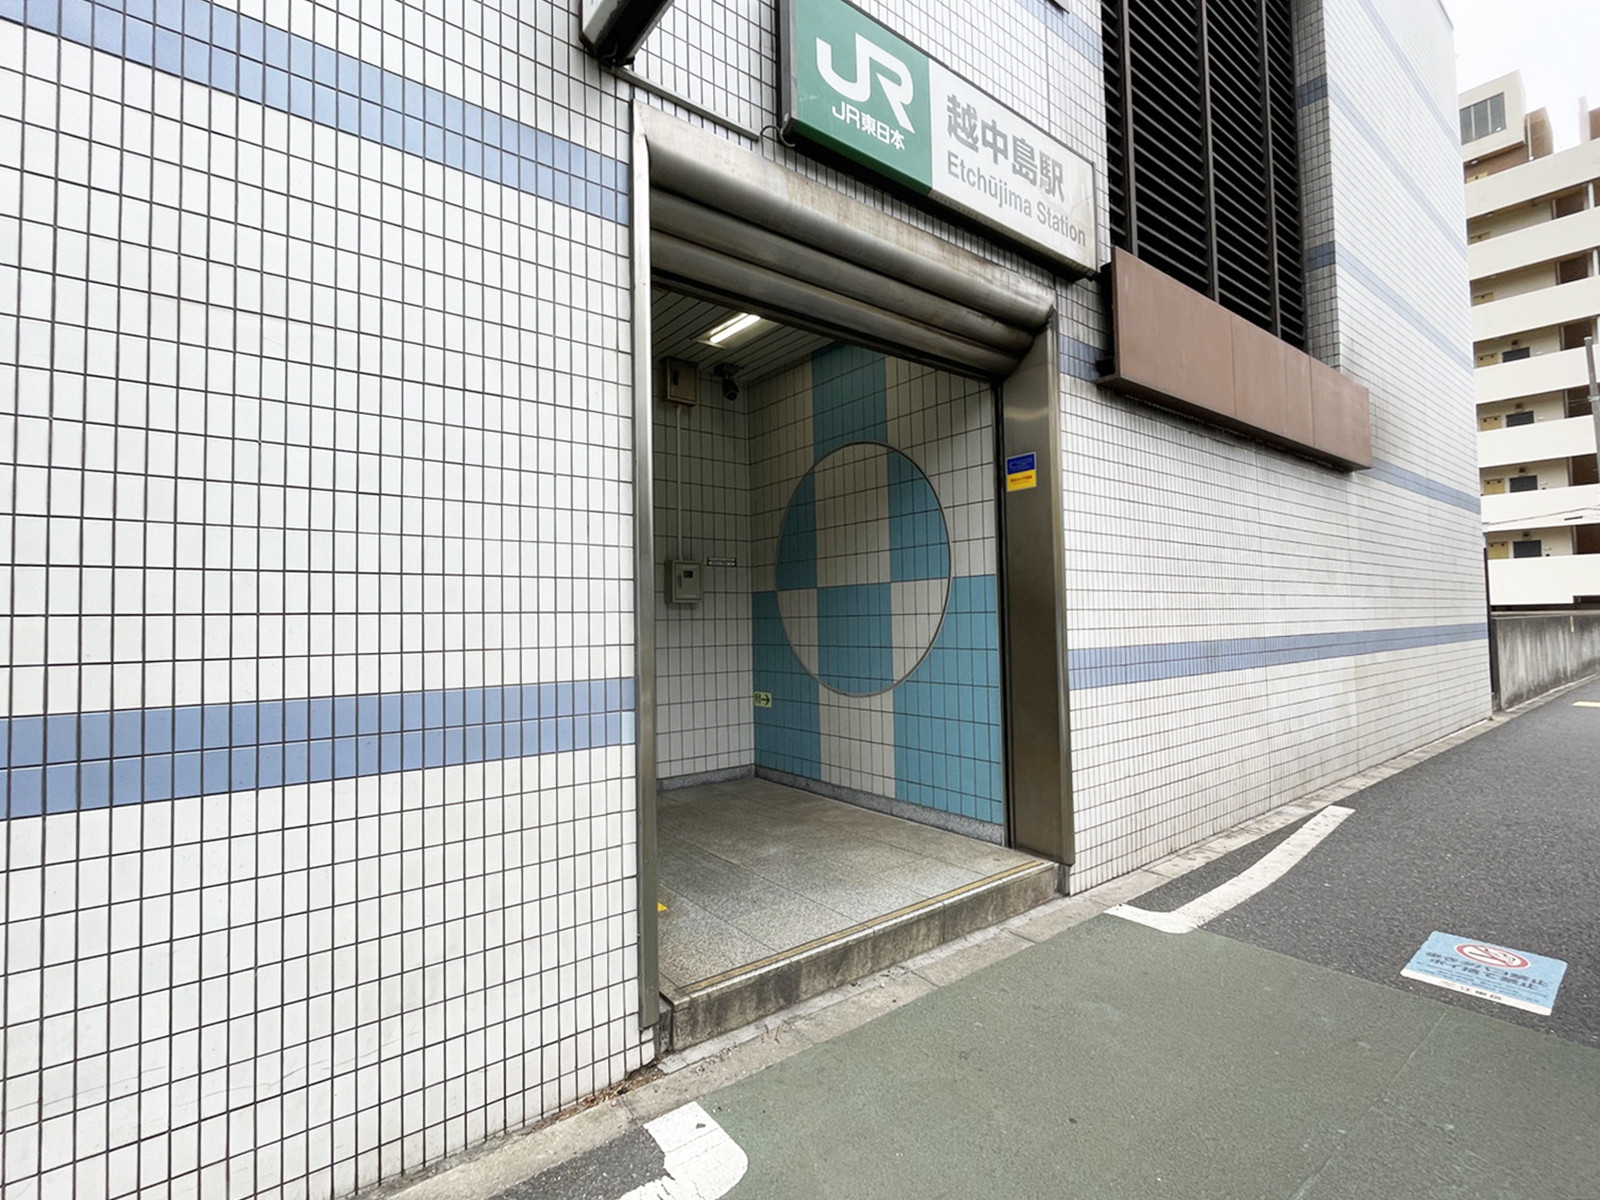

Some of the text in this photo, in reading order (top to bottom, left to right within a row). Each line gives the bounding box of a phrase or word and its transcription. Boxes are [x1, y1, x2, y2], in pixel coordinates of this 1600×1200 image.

[815, 32, 915, 134] JR
[832, 101, 905, 151] JR東日本
[947, 93, 1065, 203] 越中島駅
[947, 151, 1087, 248] Etchūjima Station
